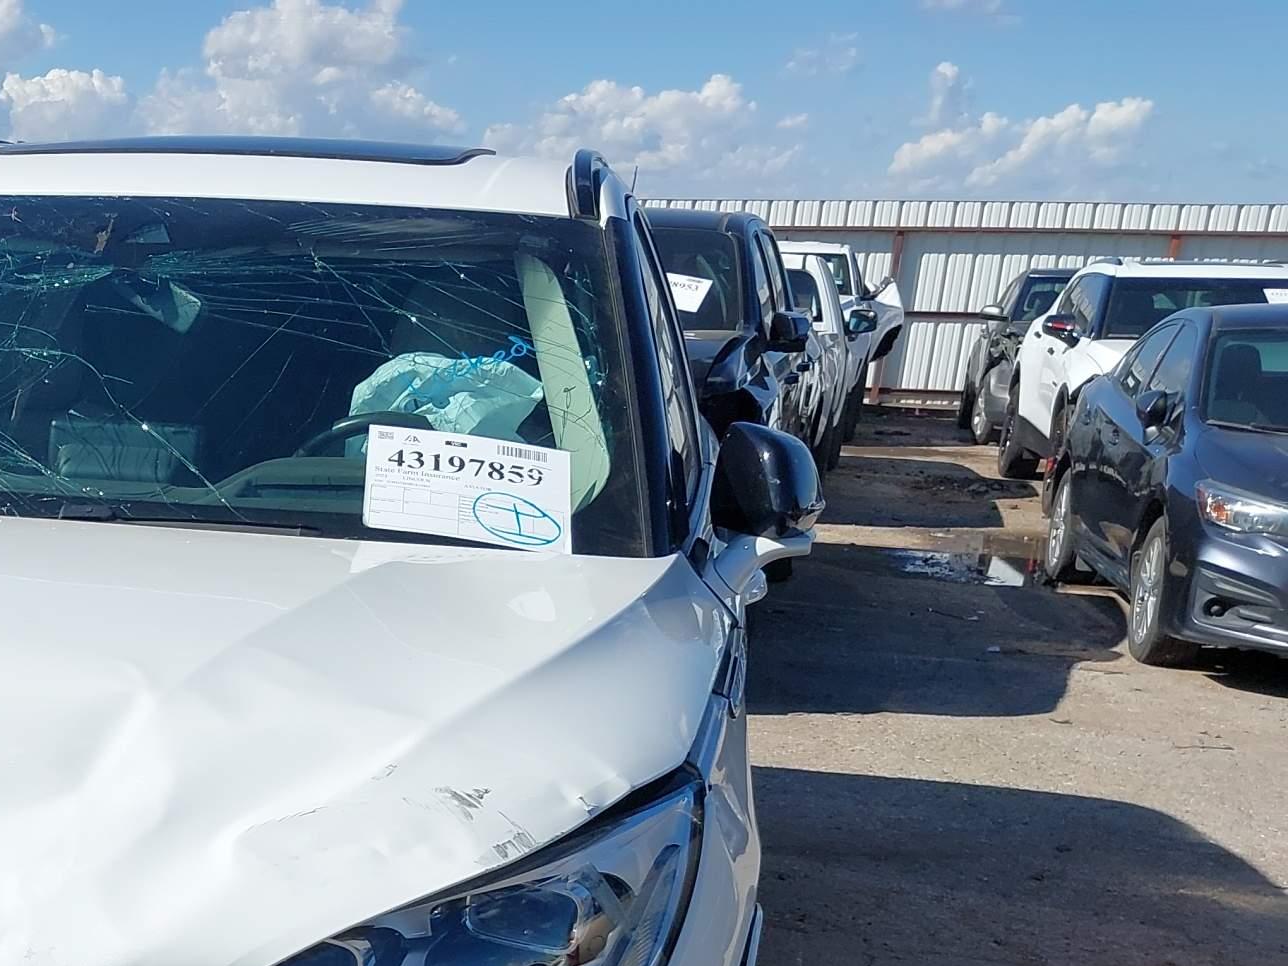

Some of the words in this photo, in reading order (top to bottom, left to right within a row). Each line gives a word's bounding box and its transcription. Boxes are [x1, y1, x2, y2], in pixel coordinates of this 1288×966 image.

[375, 466, 395, 474] State
[397, 468, 419, 477] Farm
[421, 471, 461, 481] Insurance
[388, 449, 544, 487] 43197859
